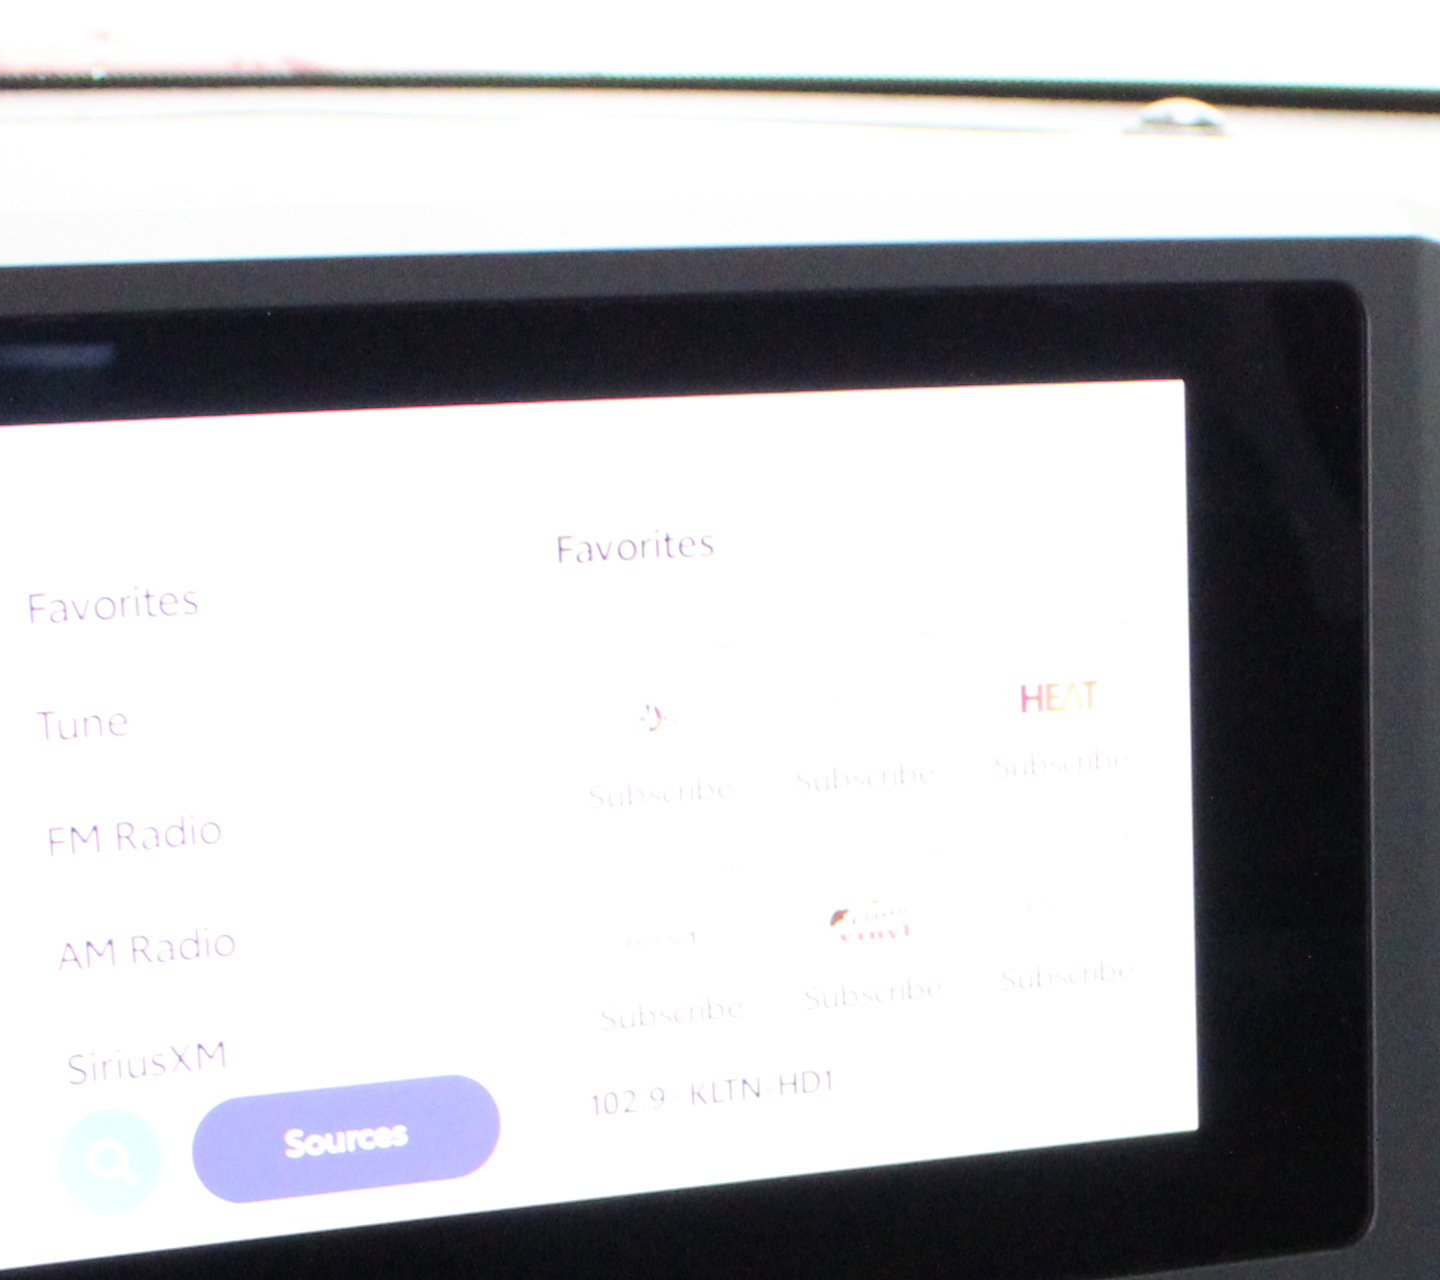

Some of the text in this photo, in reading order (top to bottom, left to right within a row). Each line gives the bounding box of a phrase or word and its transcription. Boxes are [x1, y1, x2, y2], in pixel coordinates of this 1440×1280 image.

[556, 529, 716, 564] Favorites
[28, 587, 199, 623] Favorites
[1020, 681, 1098, 714] HEAT
[36, 710, 129, 741] Tune
[48, 815, 222, 856] FM Radio
[58, 928, 236, 971] AM Radio
[68, 1040, 227, 1085] SiriusXM
[592, 1085, 665, 1117] 102.9
[283, 1121, 409, 1159] Sources
